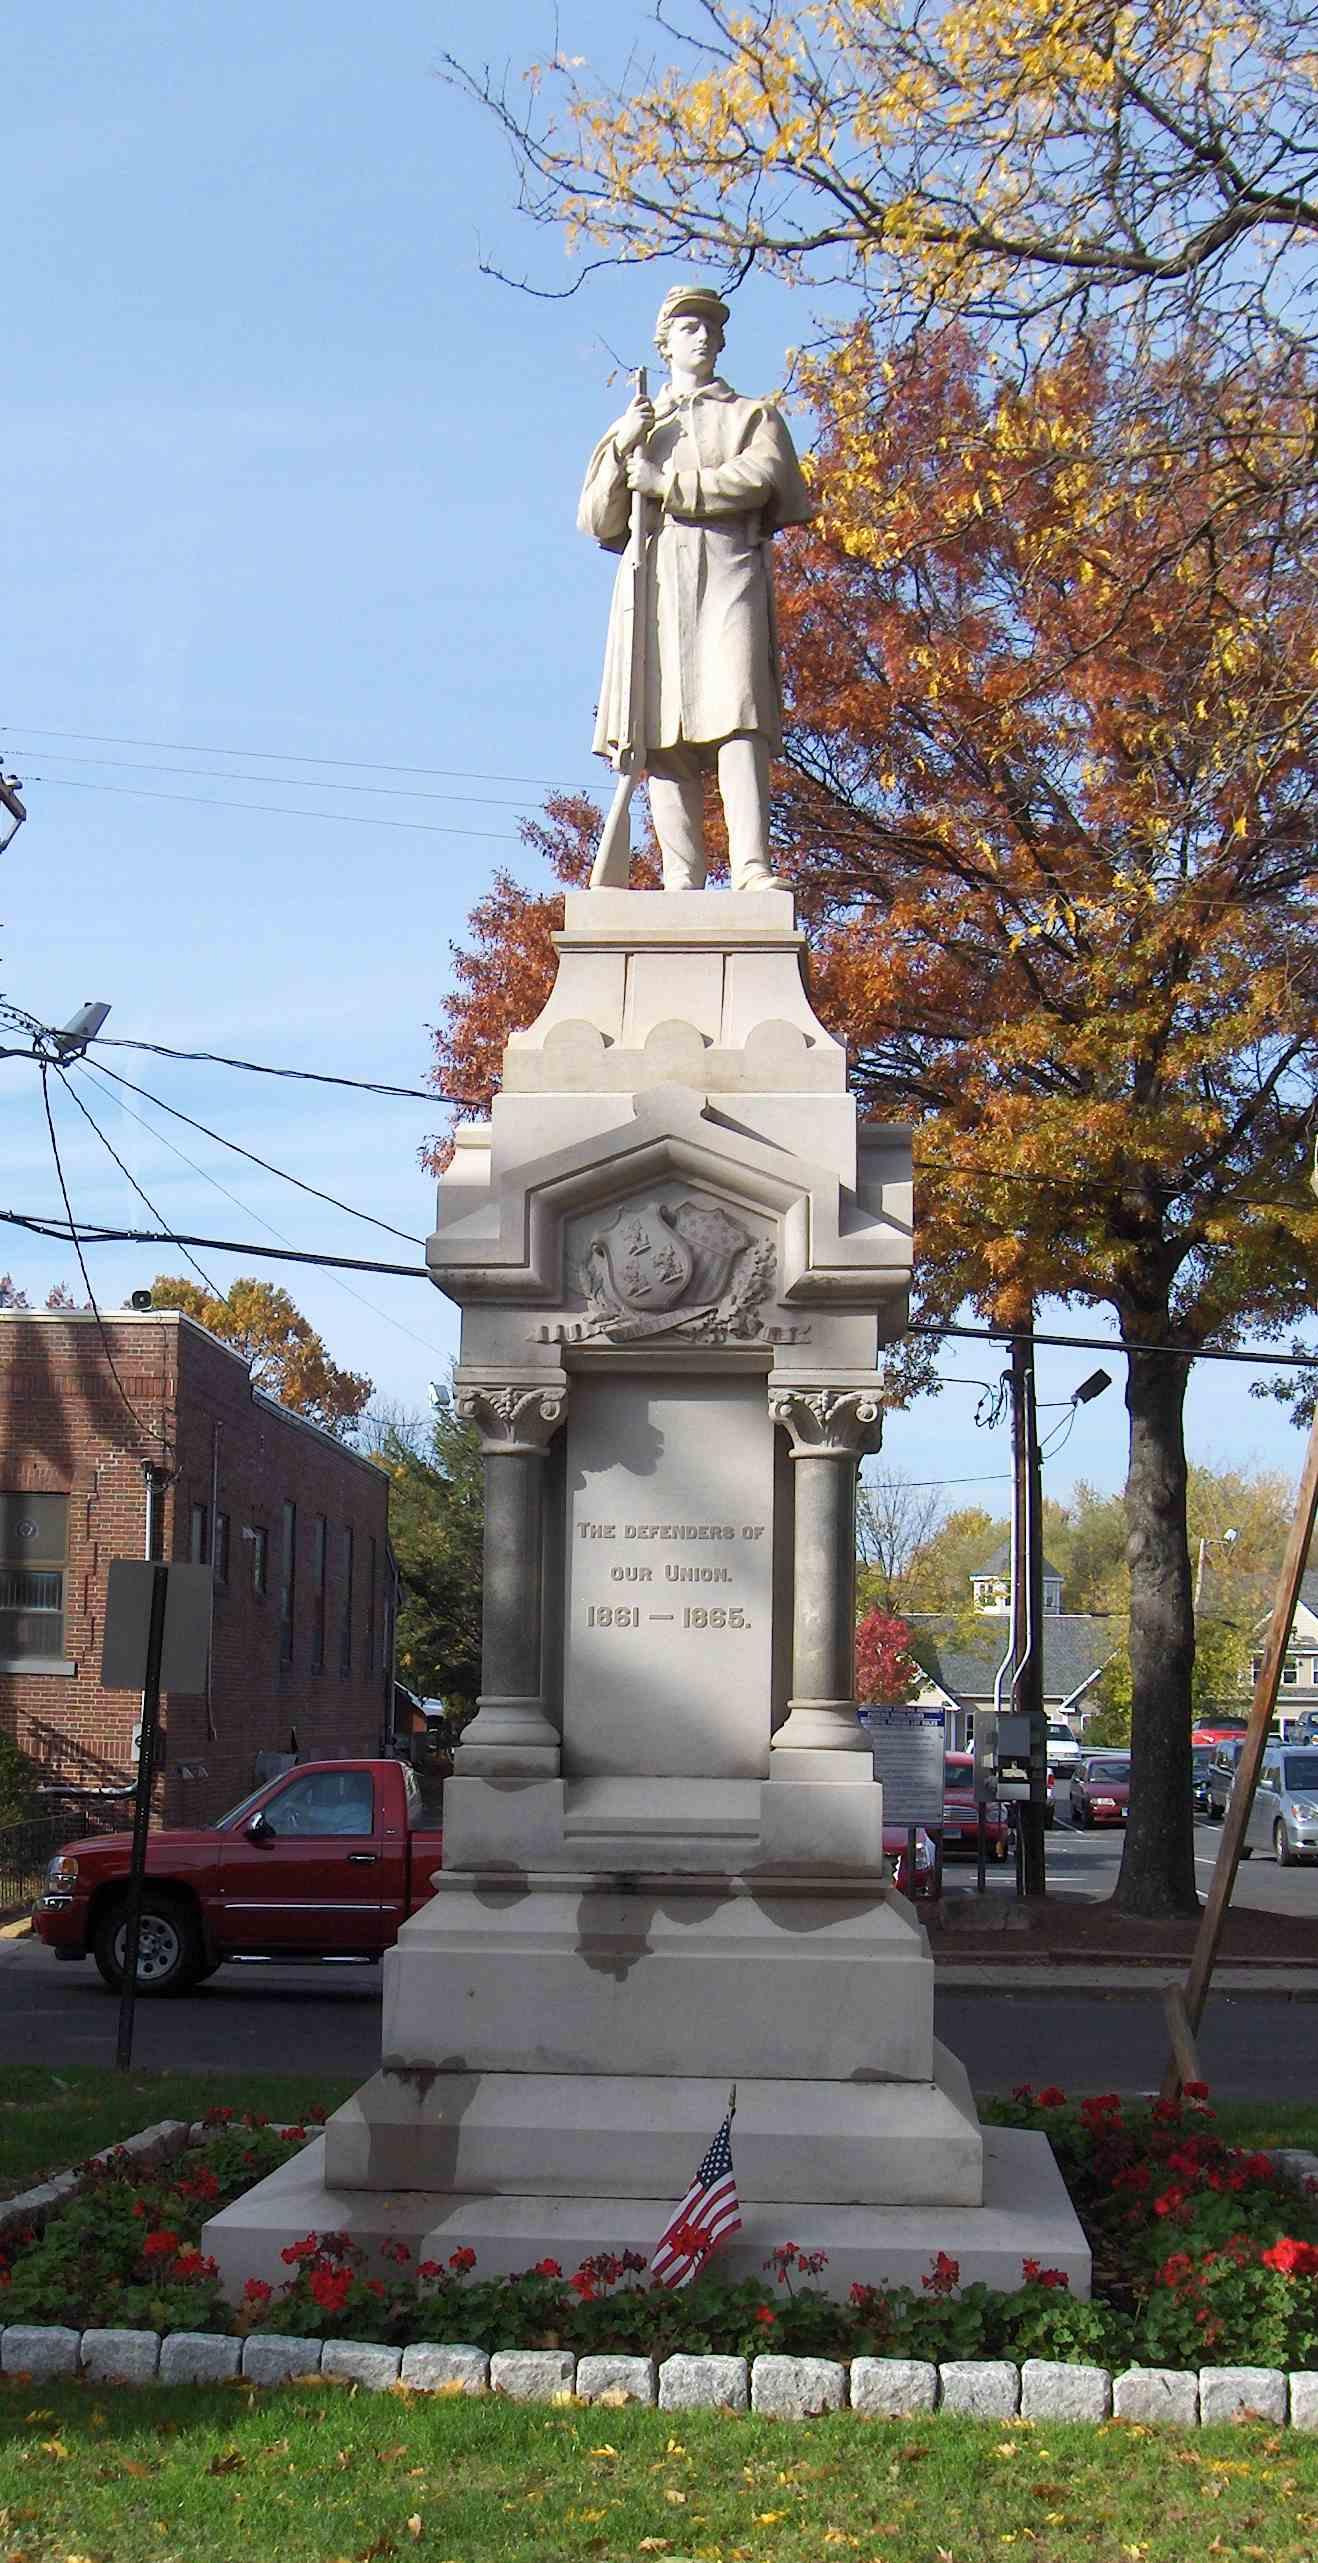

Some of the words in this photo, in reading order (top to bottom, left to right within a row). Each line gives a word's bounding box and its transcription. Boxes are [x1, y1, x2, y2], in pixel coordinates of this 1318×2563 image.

[577, 1521, 617, 1539] THE
[624, 1523, 736, 1540] DEFENDERS
[741, 1525, 765, 1540] OF
[610, 1566, 653, 1582] OUR
[586, 1605, 640, 1628] 1861
